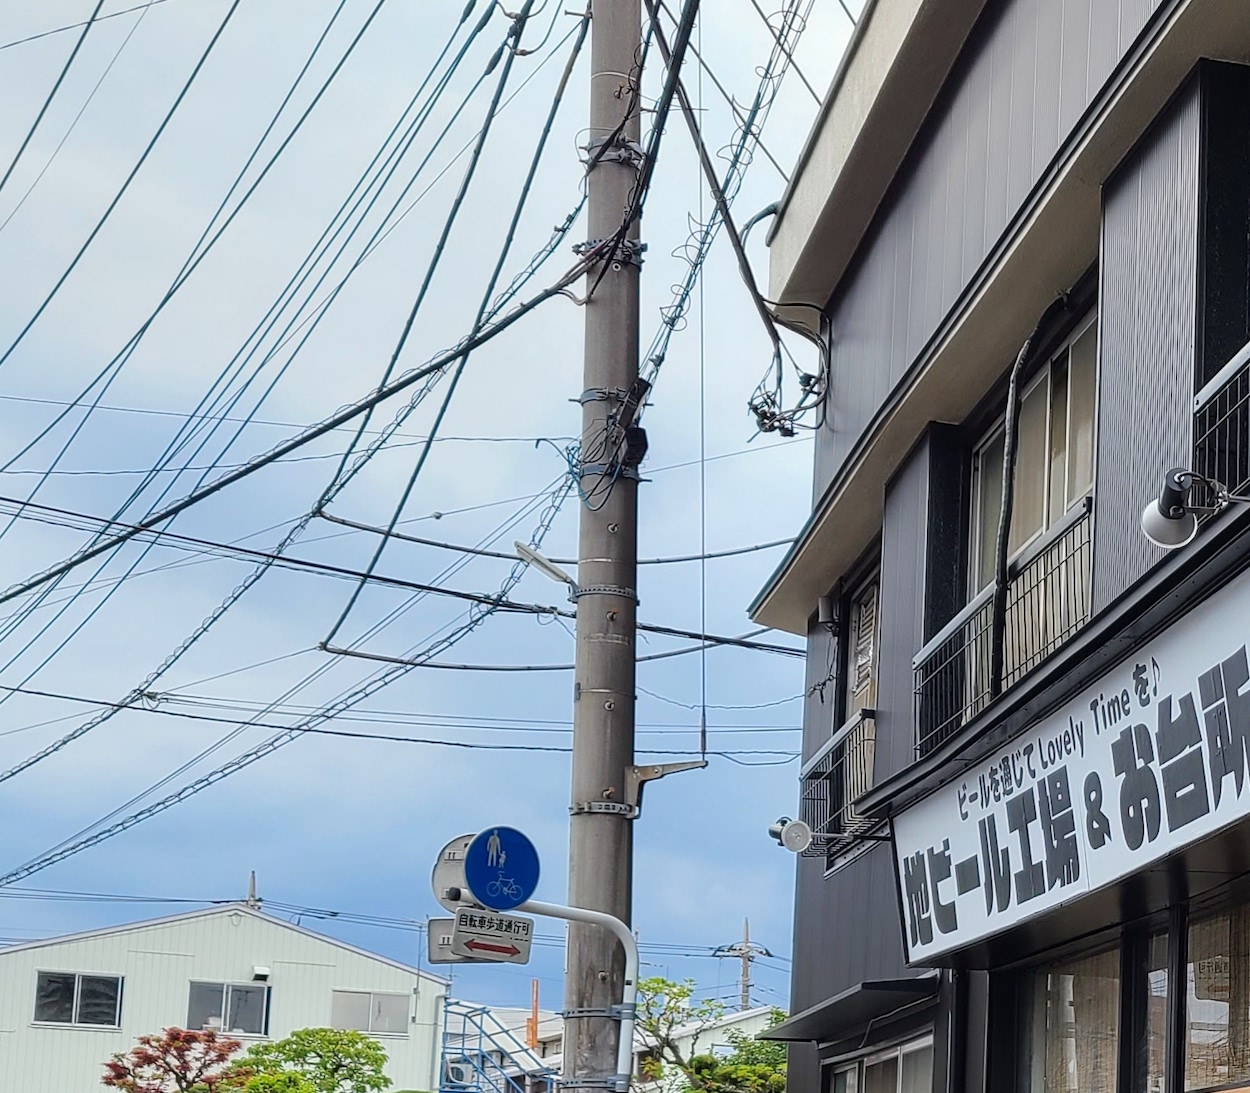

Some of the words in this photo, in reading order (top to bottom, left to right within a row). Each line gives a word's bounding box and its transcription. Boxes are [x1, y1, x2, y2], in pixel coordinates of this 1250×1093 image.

[957, 743, 1036, 821] ビールを通じて
[1038, 716, 1085, 770] Lovely
[1090, 688, 1131, 735] Time
[903, 764, 1081, 948] 地ビール工場
[1083, 771, 1113, 850] &
[459, 913, 531, 936] 自転車歩道通行可
